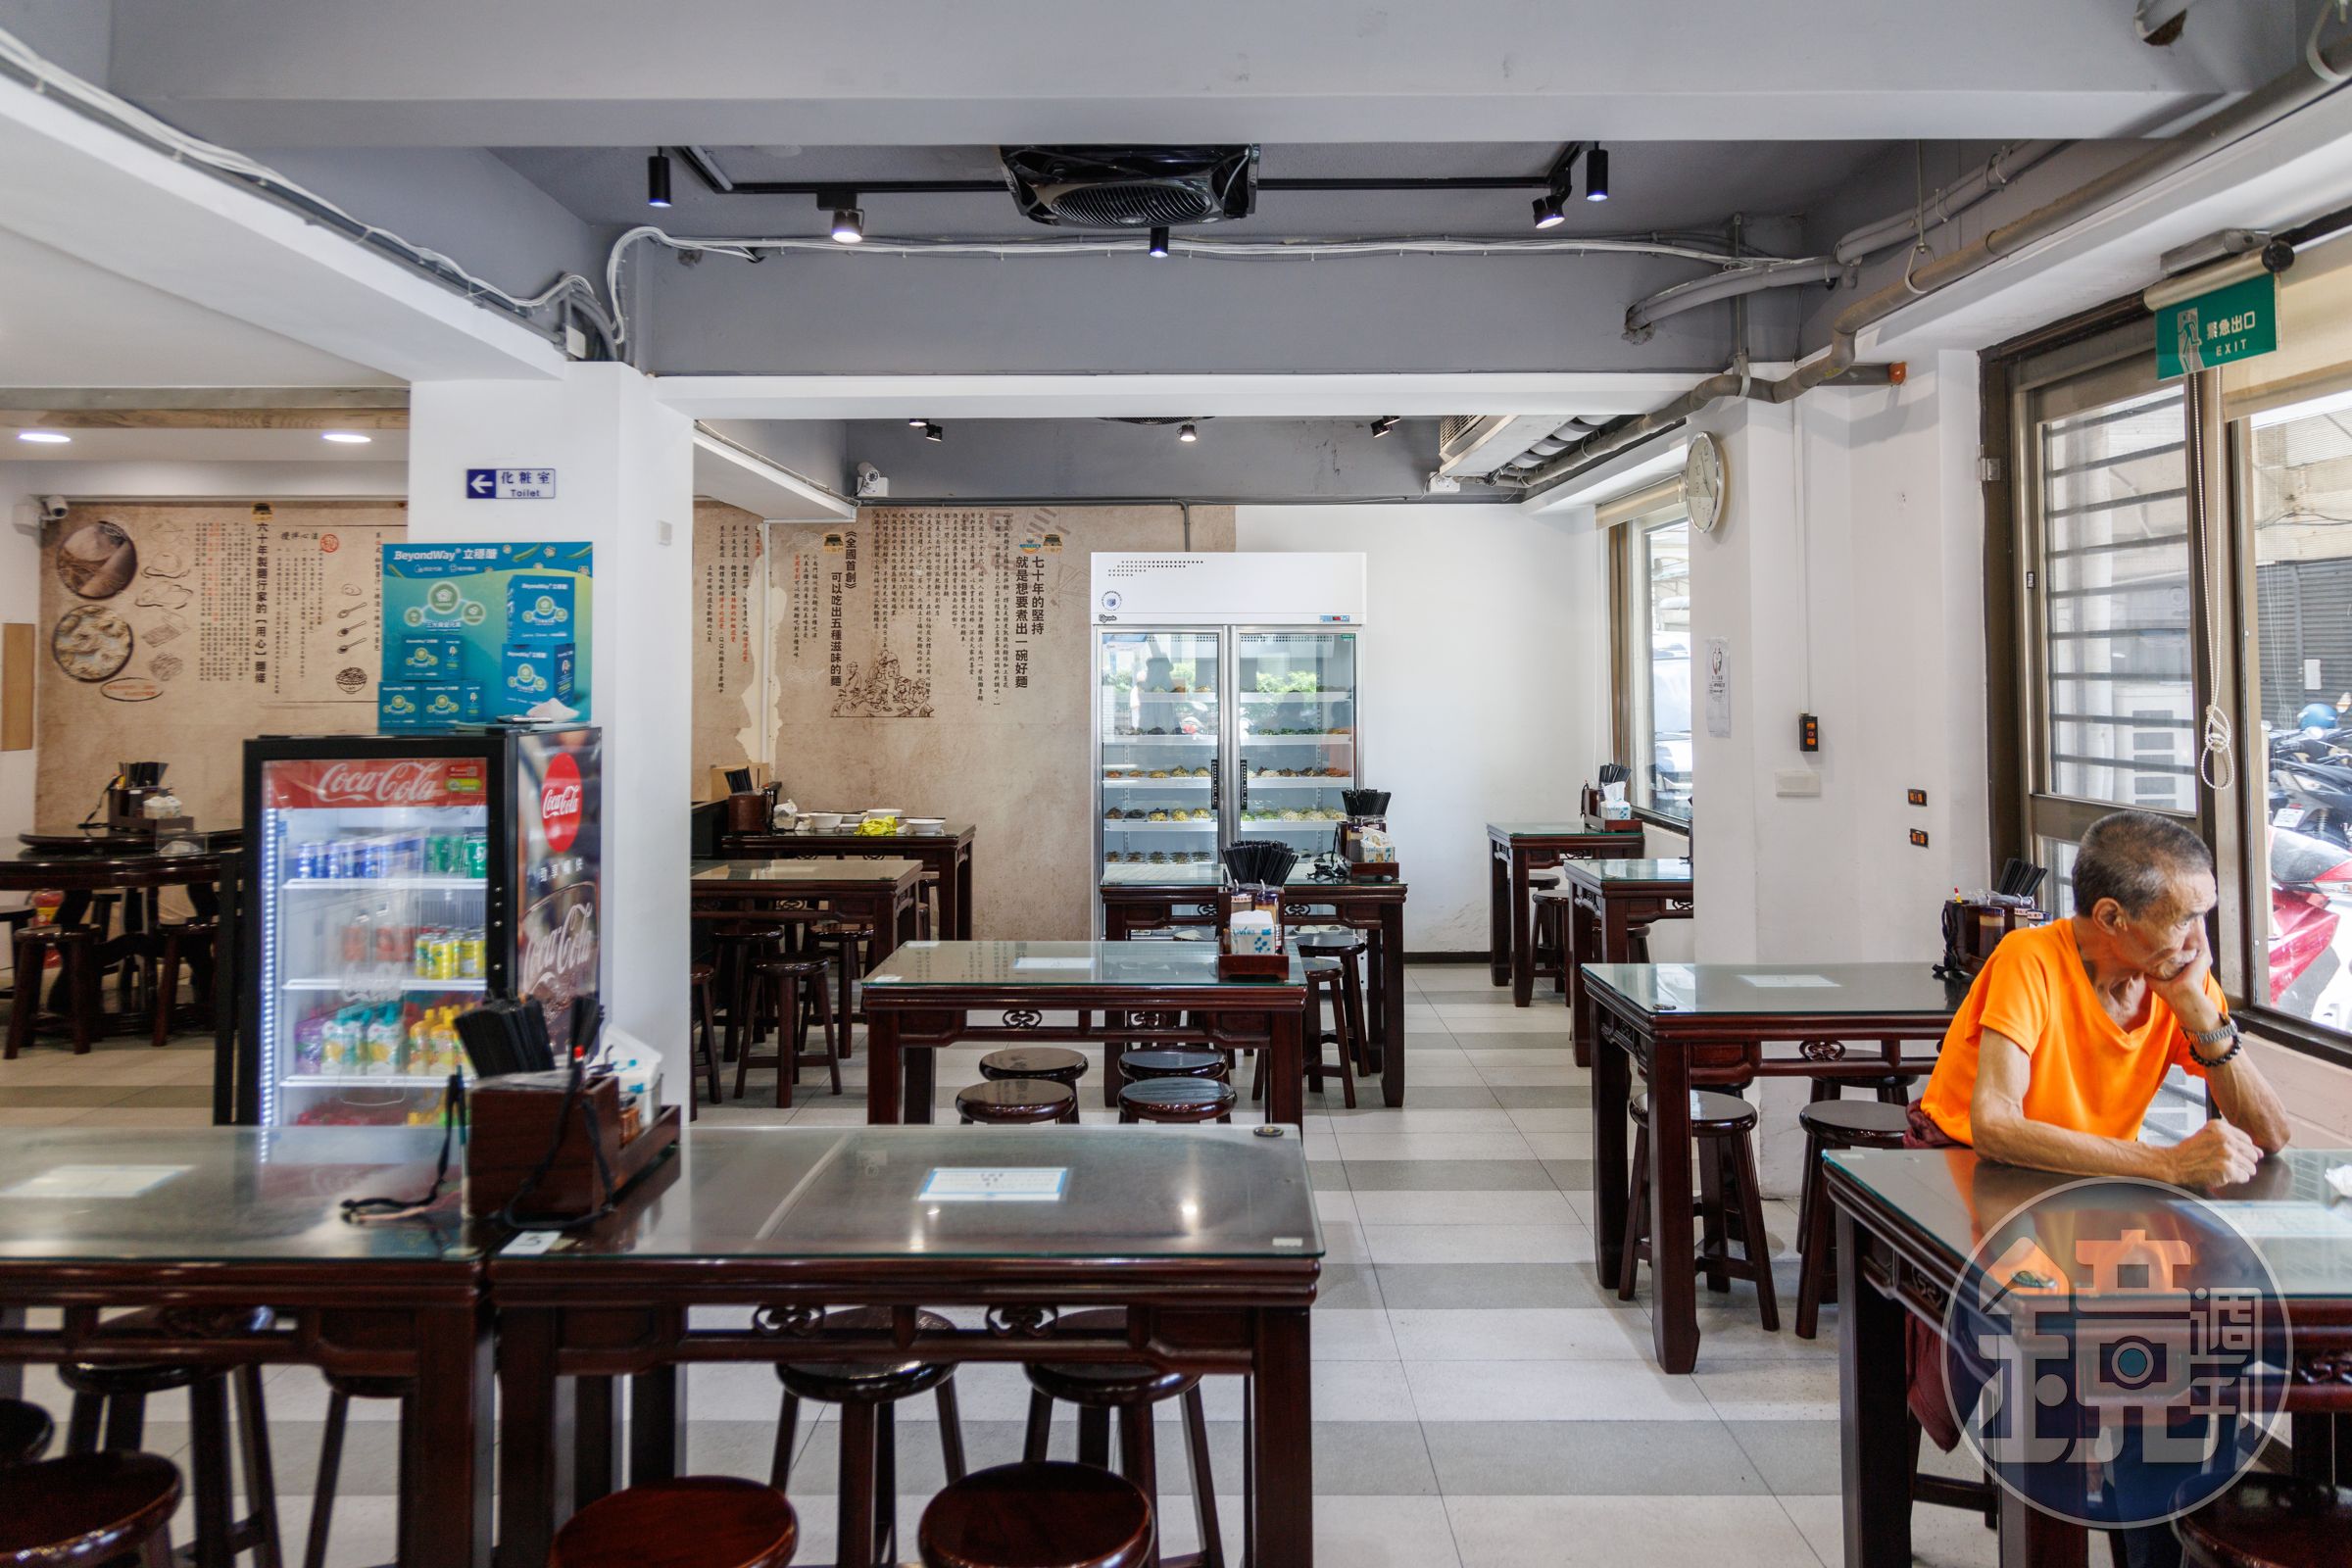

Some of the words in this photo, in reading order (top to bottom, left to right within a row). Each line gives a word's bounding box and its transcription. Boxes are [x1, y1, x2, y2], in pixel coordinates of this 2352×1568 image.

[2207, 311, 2255, 340] 緊急出口
[2216, 338, 2247, 357] EXIT
[501, 471, 550, 484] 化粧室
[393, 550, 456, 562] BeyondWay
[845, 531, 857, 589] 《全國首創》
[1032, 556, 1045, 635] 七十年的堅持
[830, 572, 843, 686] 可以吃出五種滋味的麵
[1014, 556, 1028, 688] 就是想要煮出一碗好麵
[316, 761, 444, 803] Coca-Cola
[542, 785, 580, 819] Coca-Cola
